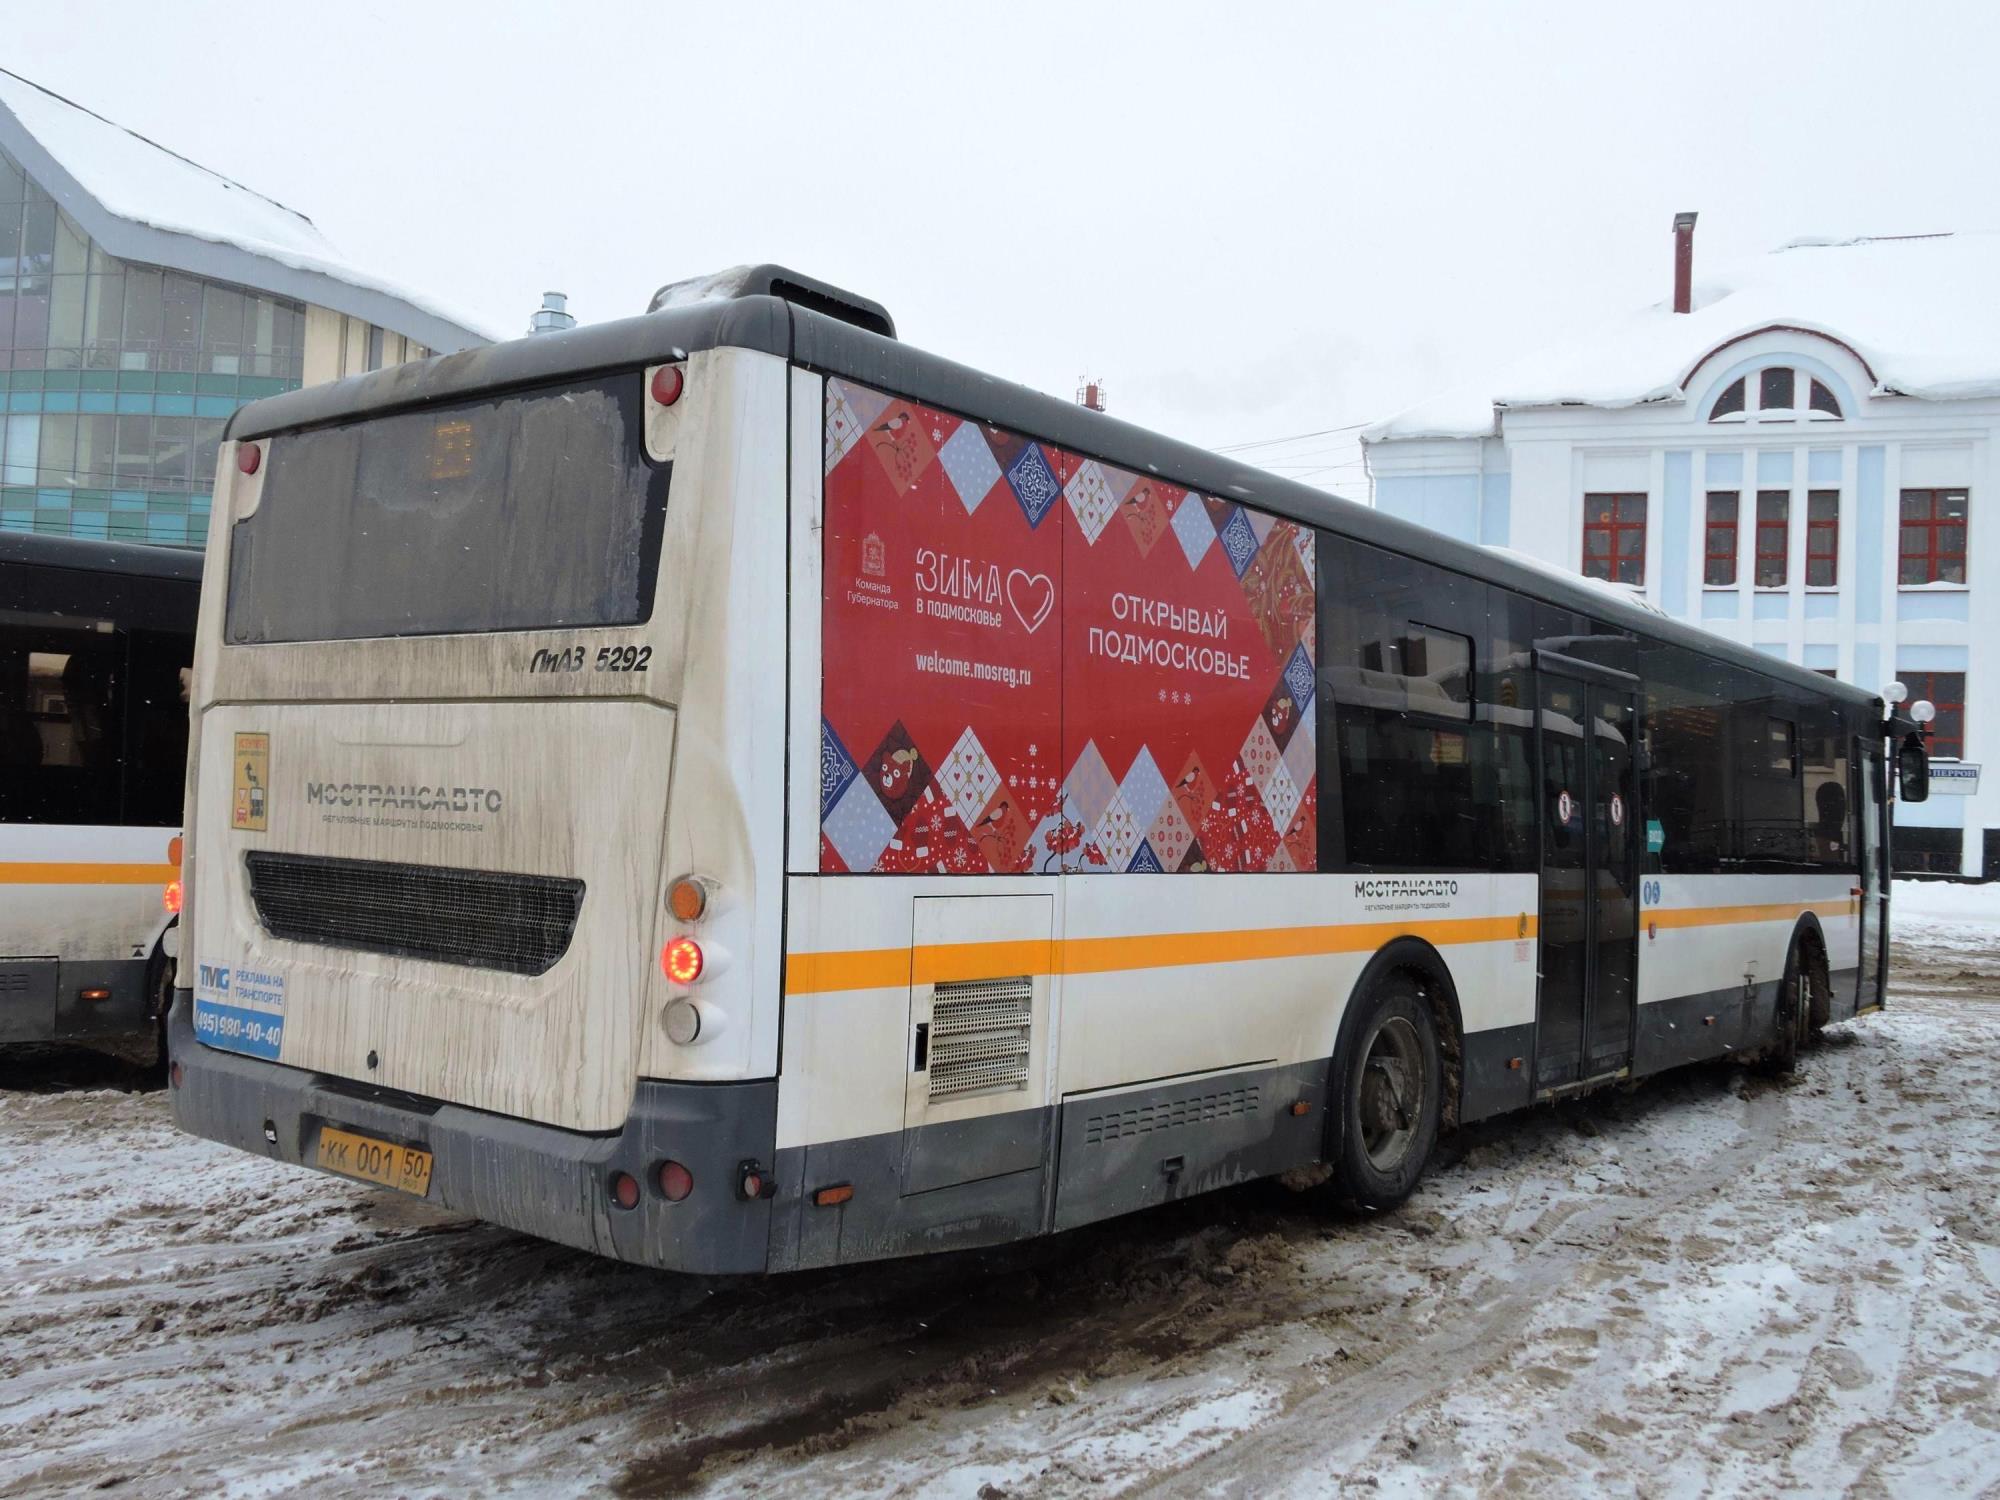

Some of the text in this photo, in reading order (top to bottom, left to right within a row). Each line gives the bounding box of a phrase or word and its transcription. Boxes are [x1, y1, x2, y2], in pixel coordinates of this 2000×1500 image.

[855, 577, 891, 594] Команда
[915, 548, 1003, 606] ЗИМА
[847, 590, 899, 610] Губернатора
[1111, 592, 1227, 640] ОТКРЫВАЙ
[595, 645, 652, 672] 5292
[1089, 627, 1250, 680] ПОДМОСКОВЬЕ
[916, 651, 1031, 689] welcome.mosreg.ru
[307, 782, 502, 813] МОСТРАНСАВТО
[1355, 880, 1458, 898] МОСТРАНСАВТО
[236, 969, 284, 988] РЕКЛАМА НА
[235, 986, 282, 1005] ТРАНСПОРТЕ
[357, 1143, 393, 1180] 001
[404, 1152, 424, 1178] 50
